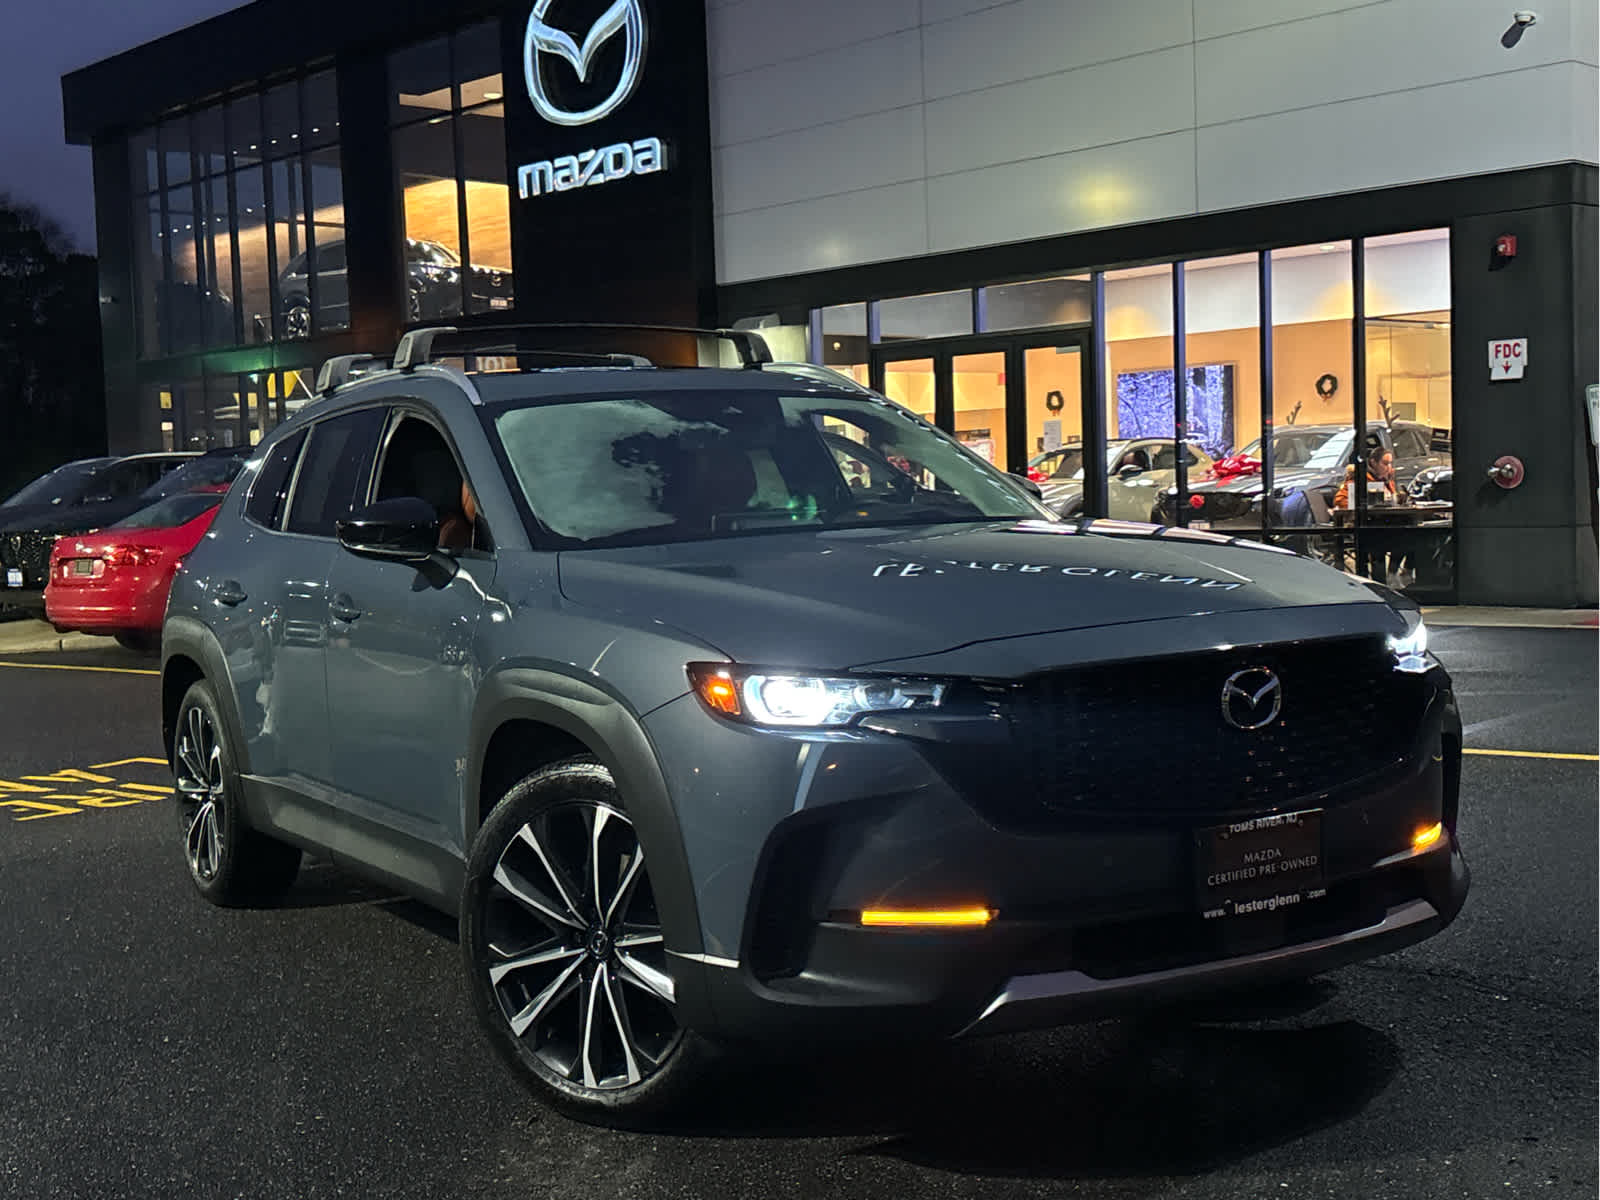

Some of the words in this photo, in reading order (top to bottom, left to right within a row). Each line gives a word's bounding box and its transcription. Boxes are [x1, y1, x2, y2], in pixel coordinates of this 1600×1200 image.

[517, 136, 664, 200] mazda
[1494, 342, 1521, 359] FDC
[1229, 819, 1255, 834] TOMS
[1243, 848, 1281, 864] MAZDA
[1208, 867, 1257, 887] CERTIFIED
[1234, 893, 1300, 915] lesterglenn
